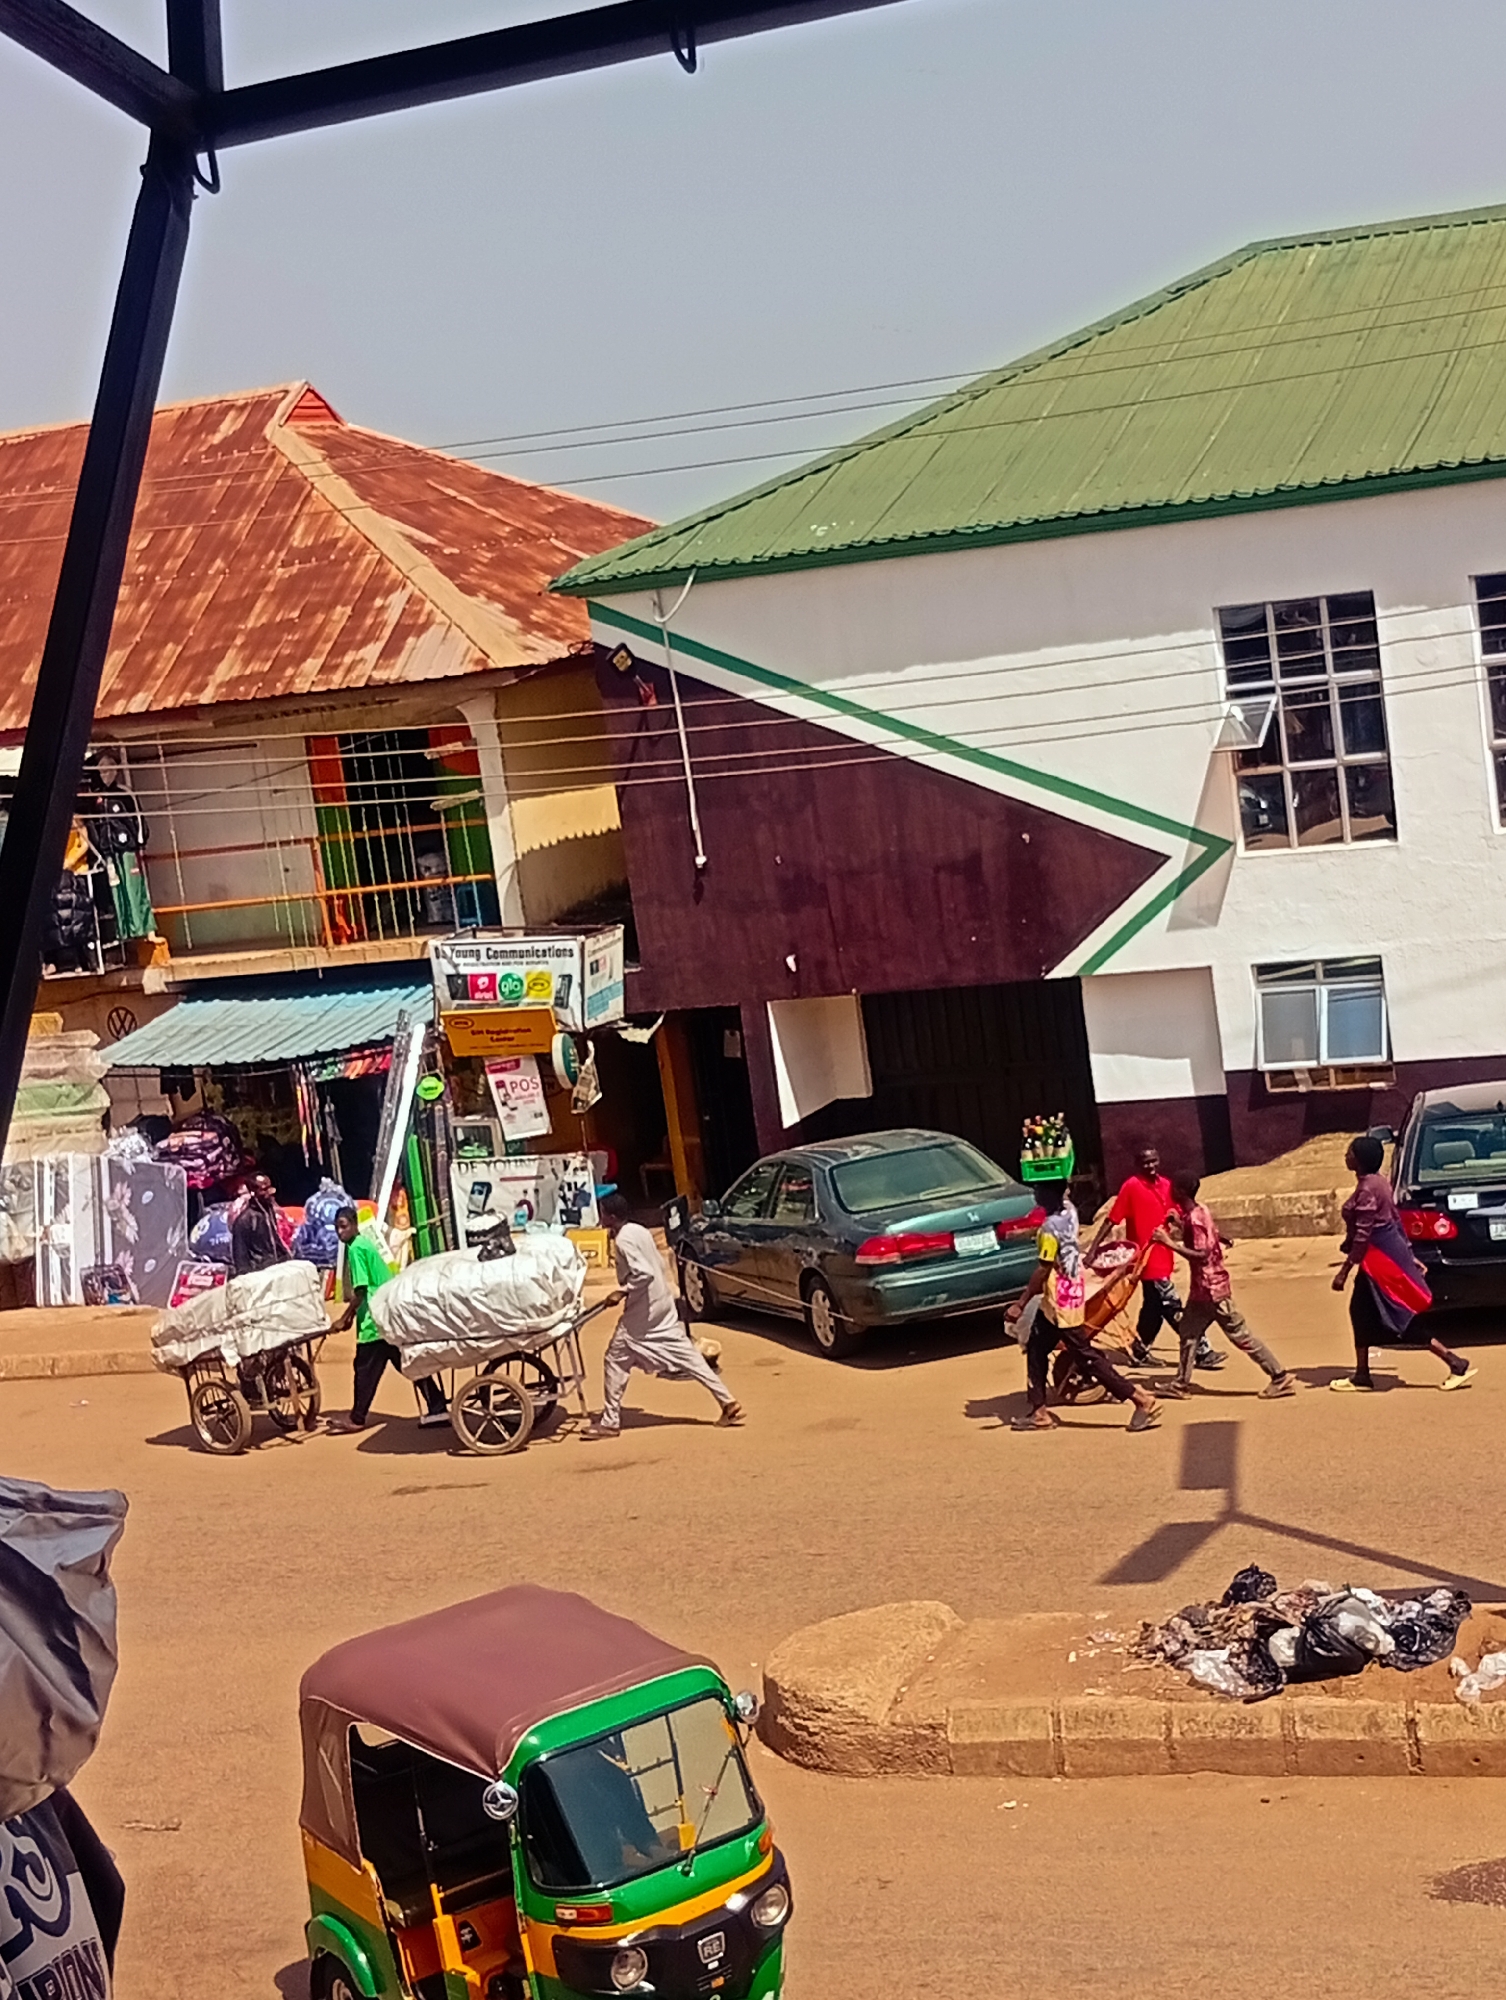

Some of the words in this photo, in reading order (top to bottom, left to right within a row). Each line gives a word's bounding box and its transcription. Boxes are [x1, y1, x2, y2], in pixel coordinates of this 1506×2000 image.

[486, 945, 574, 960] Communications
[501, 978, 520, 995] glo
[509, 1076, 540, 1094] POS
[703, 1940, 720, 1957] RE
